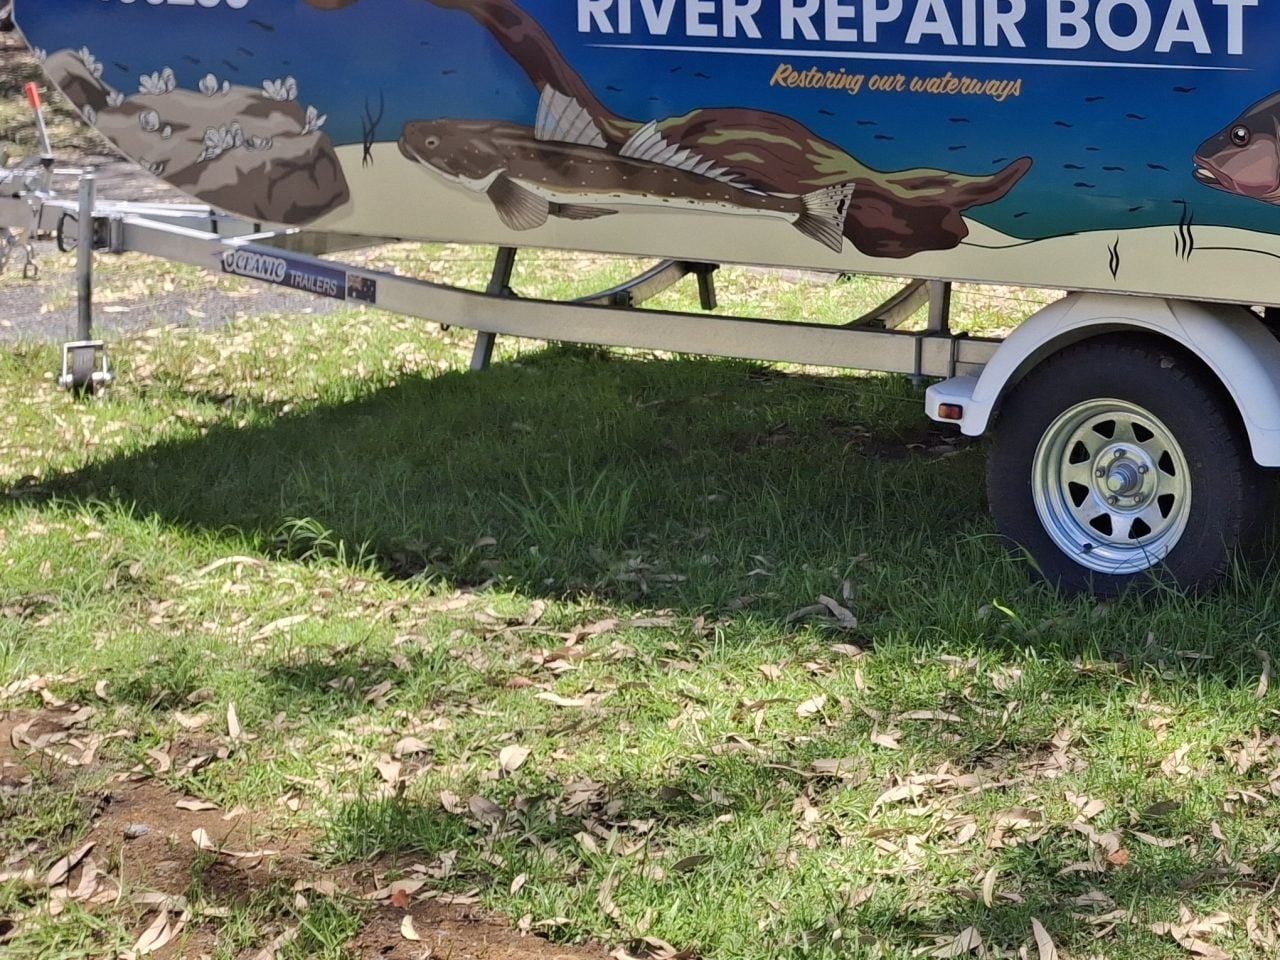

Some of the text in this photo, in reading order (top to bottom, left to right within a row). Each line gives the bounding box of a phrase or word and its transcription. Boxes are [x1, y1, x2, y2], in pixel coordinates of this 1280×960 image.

[770, 63, 1022, 102] Restoring our waterways
[288, 269, 338, 296] TRAILERS
